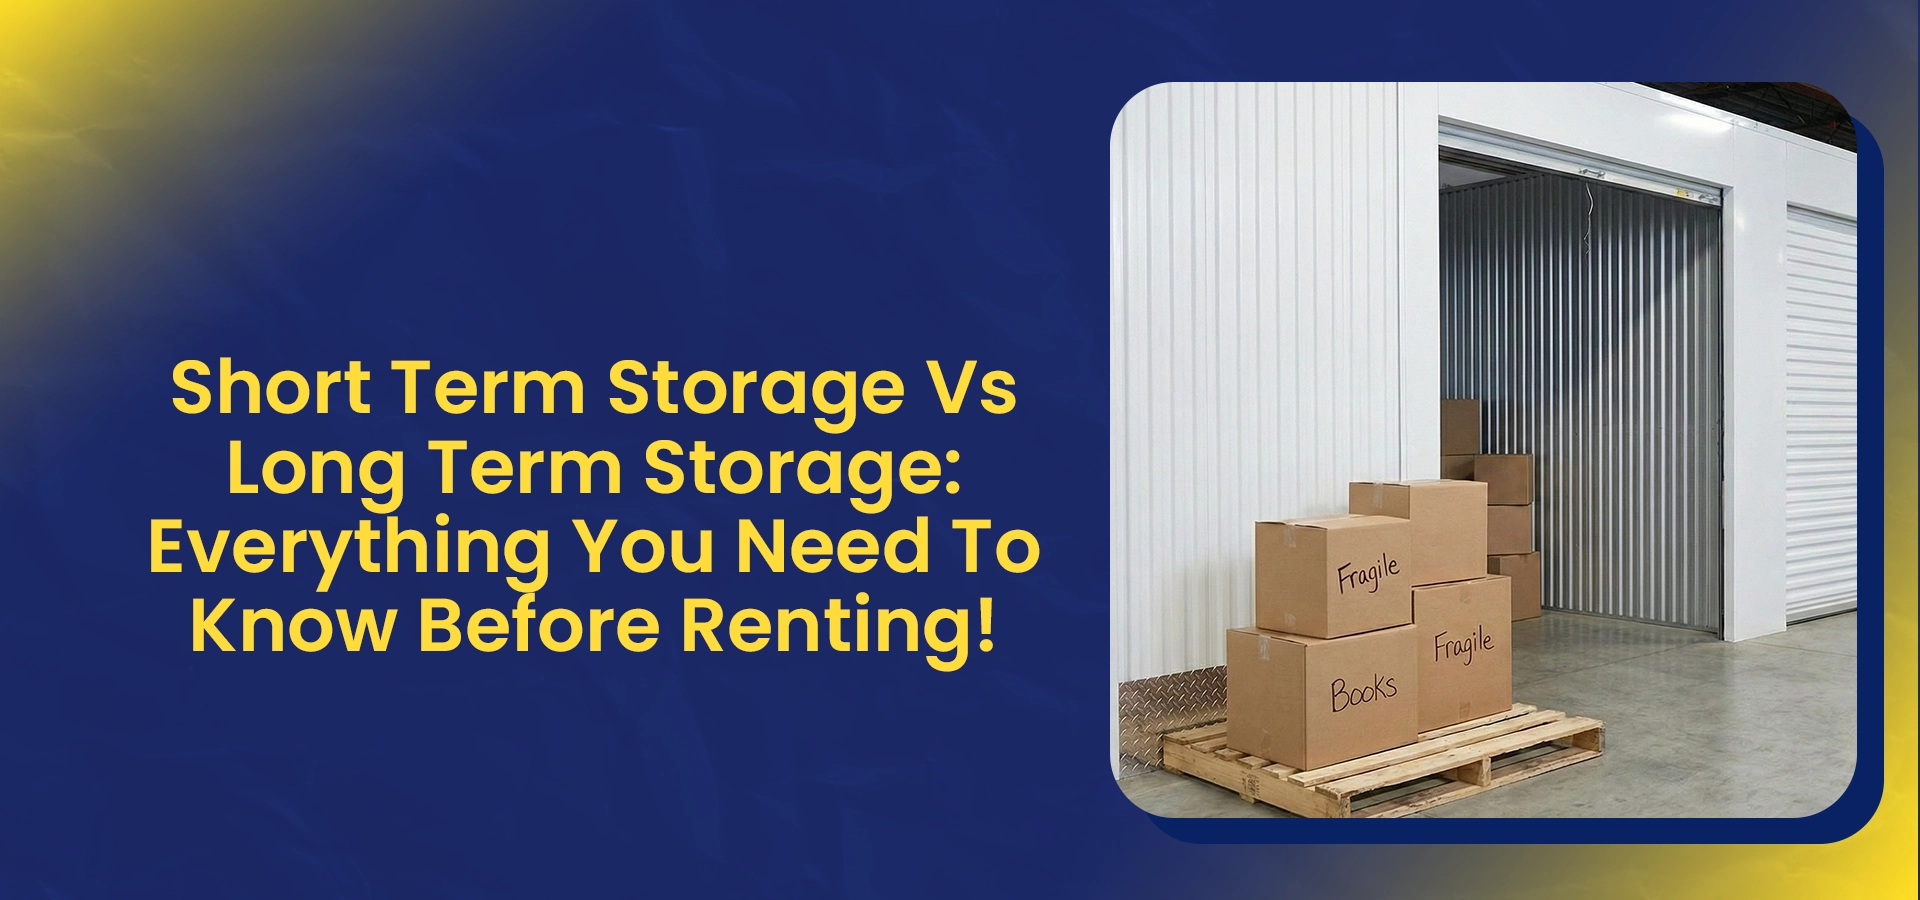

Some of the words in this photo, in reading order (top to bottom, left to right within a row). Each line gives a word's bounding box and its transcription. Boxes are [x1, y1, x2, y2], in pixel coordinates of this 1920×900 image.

[1337, 552, 1400, 594] Fragile
[1434, 624, 1495, 667] Fragile
[1331, 673, 1398, 713] Books
